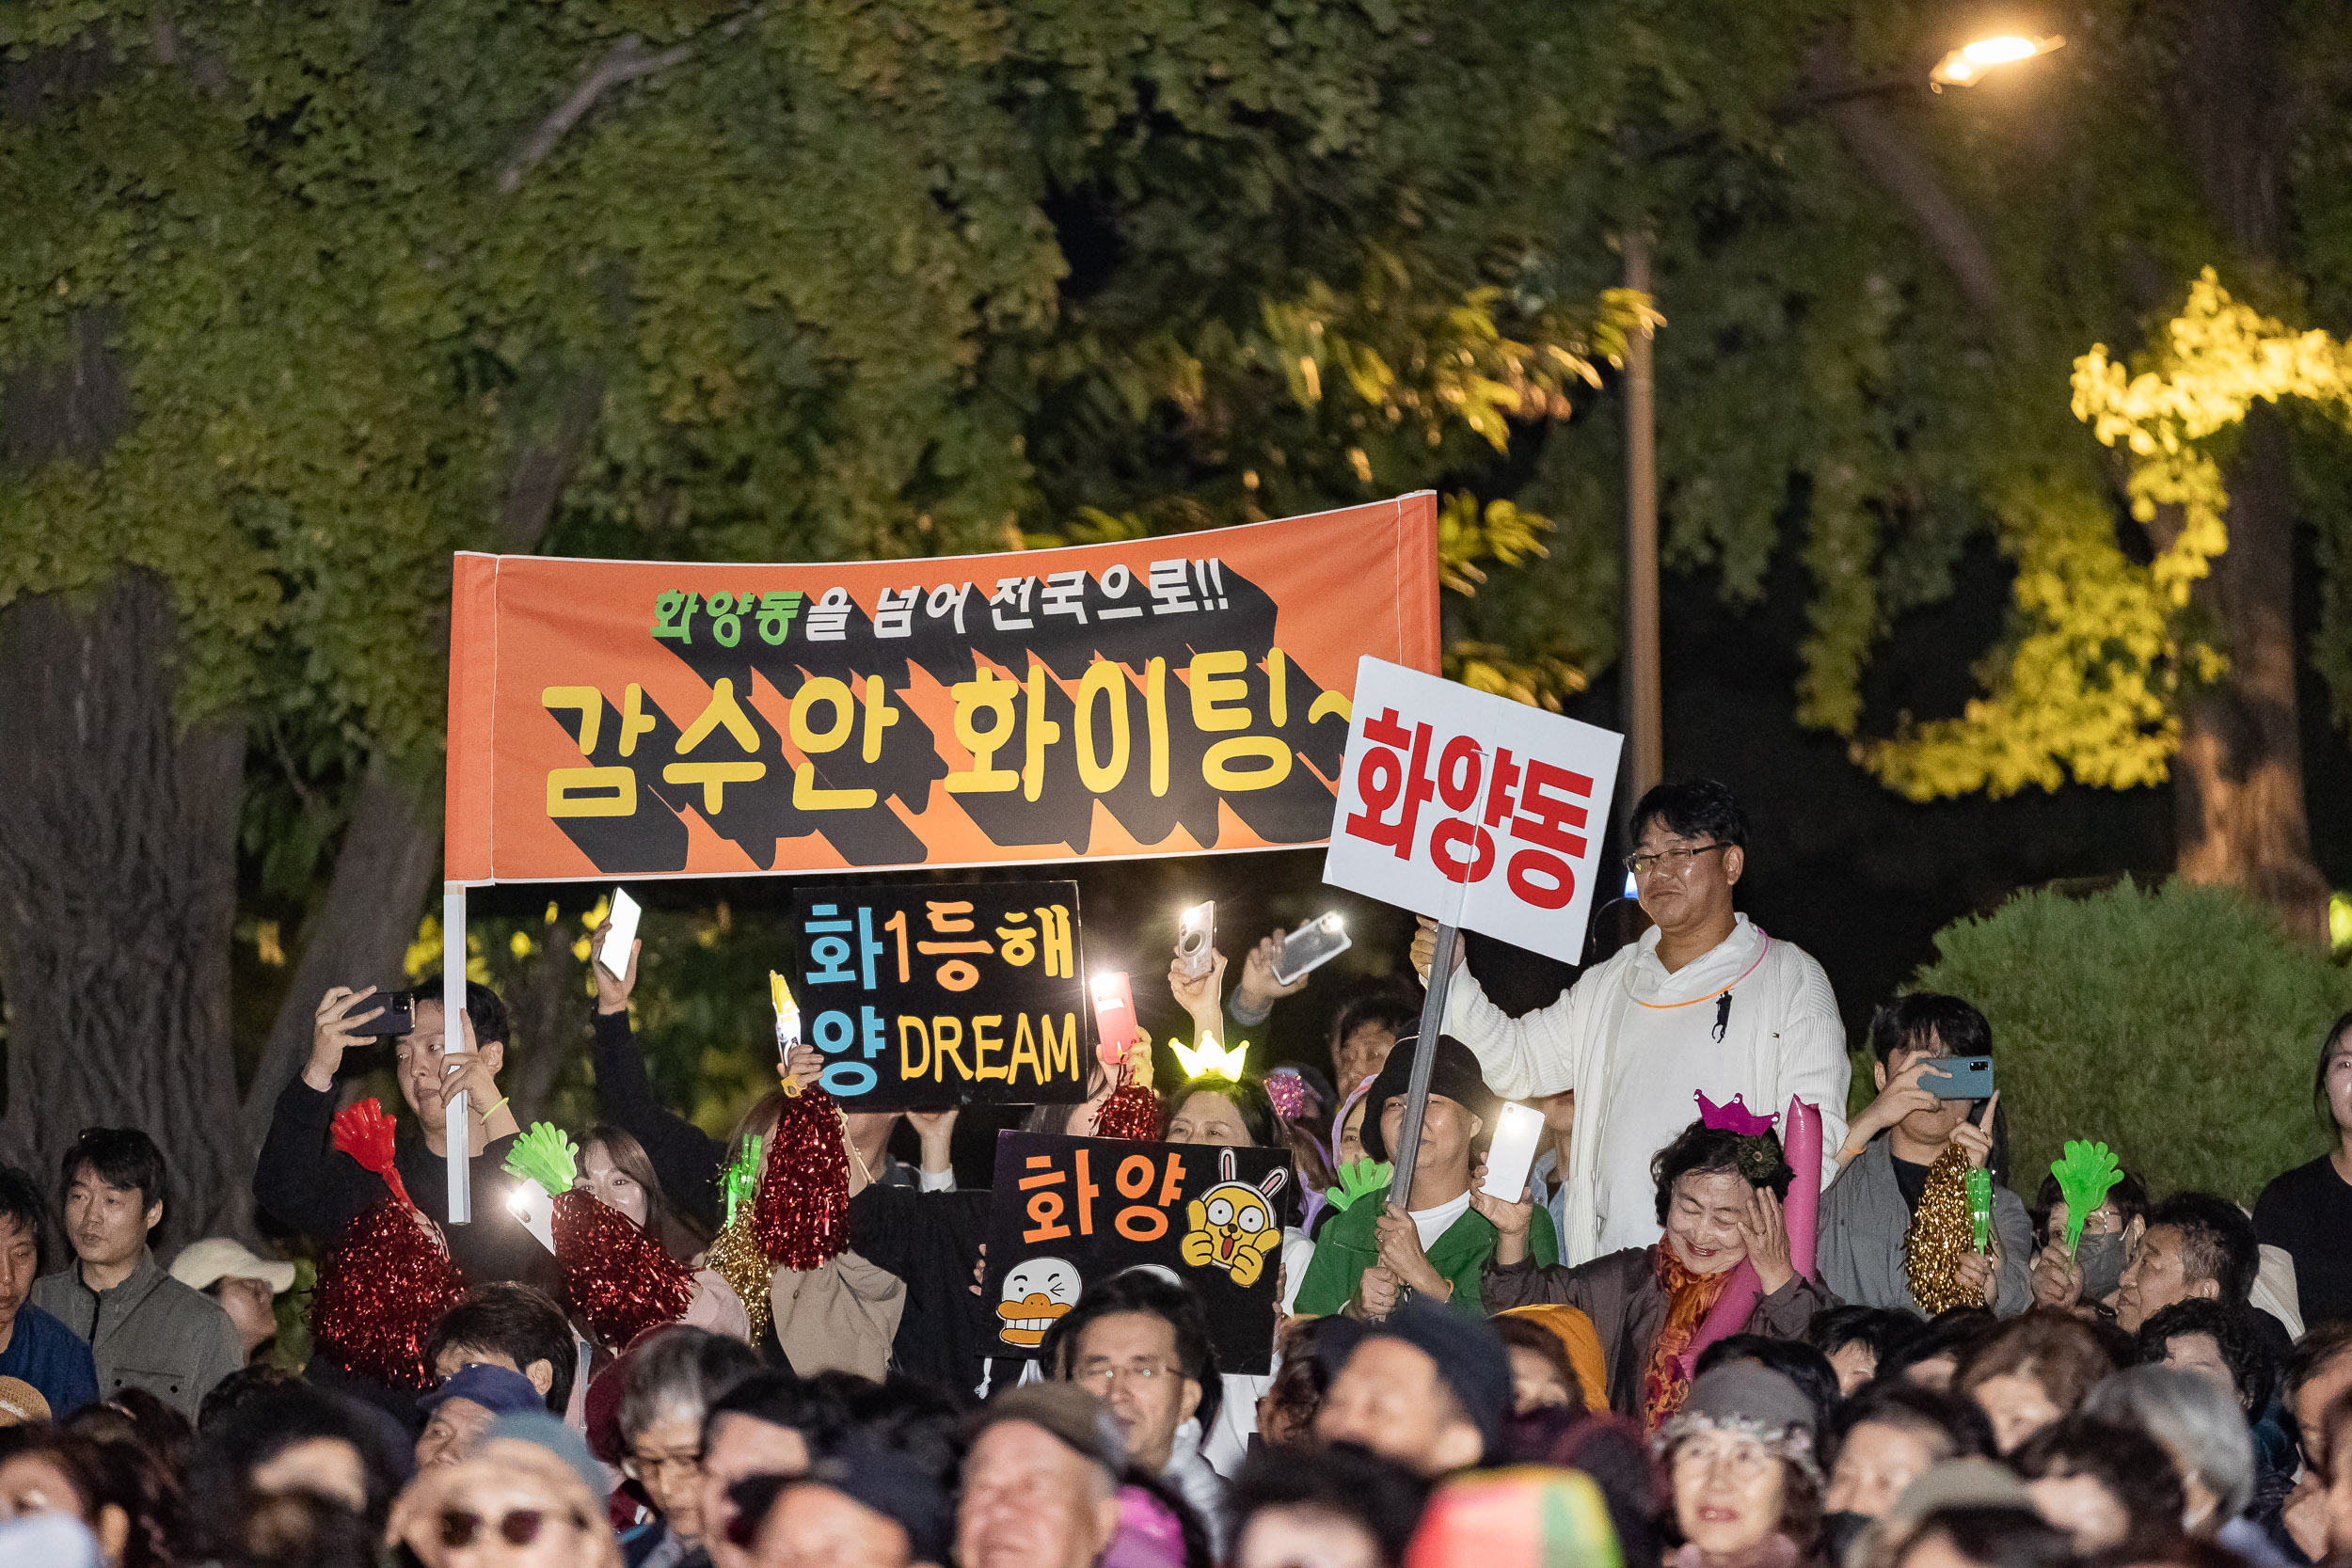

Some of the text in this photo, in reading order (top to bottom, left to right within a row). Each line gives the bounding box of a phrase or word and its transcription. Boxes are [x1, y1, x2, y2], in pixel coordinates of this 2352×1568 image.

[651, 556, 1231, 648] 화양동을 넘어 전국으로!!
[541, 674, 900, 817] 감수안
[1345, 706, 1594, 910] 화양동
[897, 1012, 1079, 1085] DREAM
[1018, 1148, 1186, 1243] 화양
